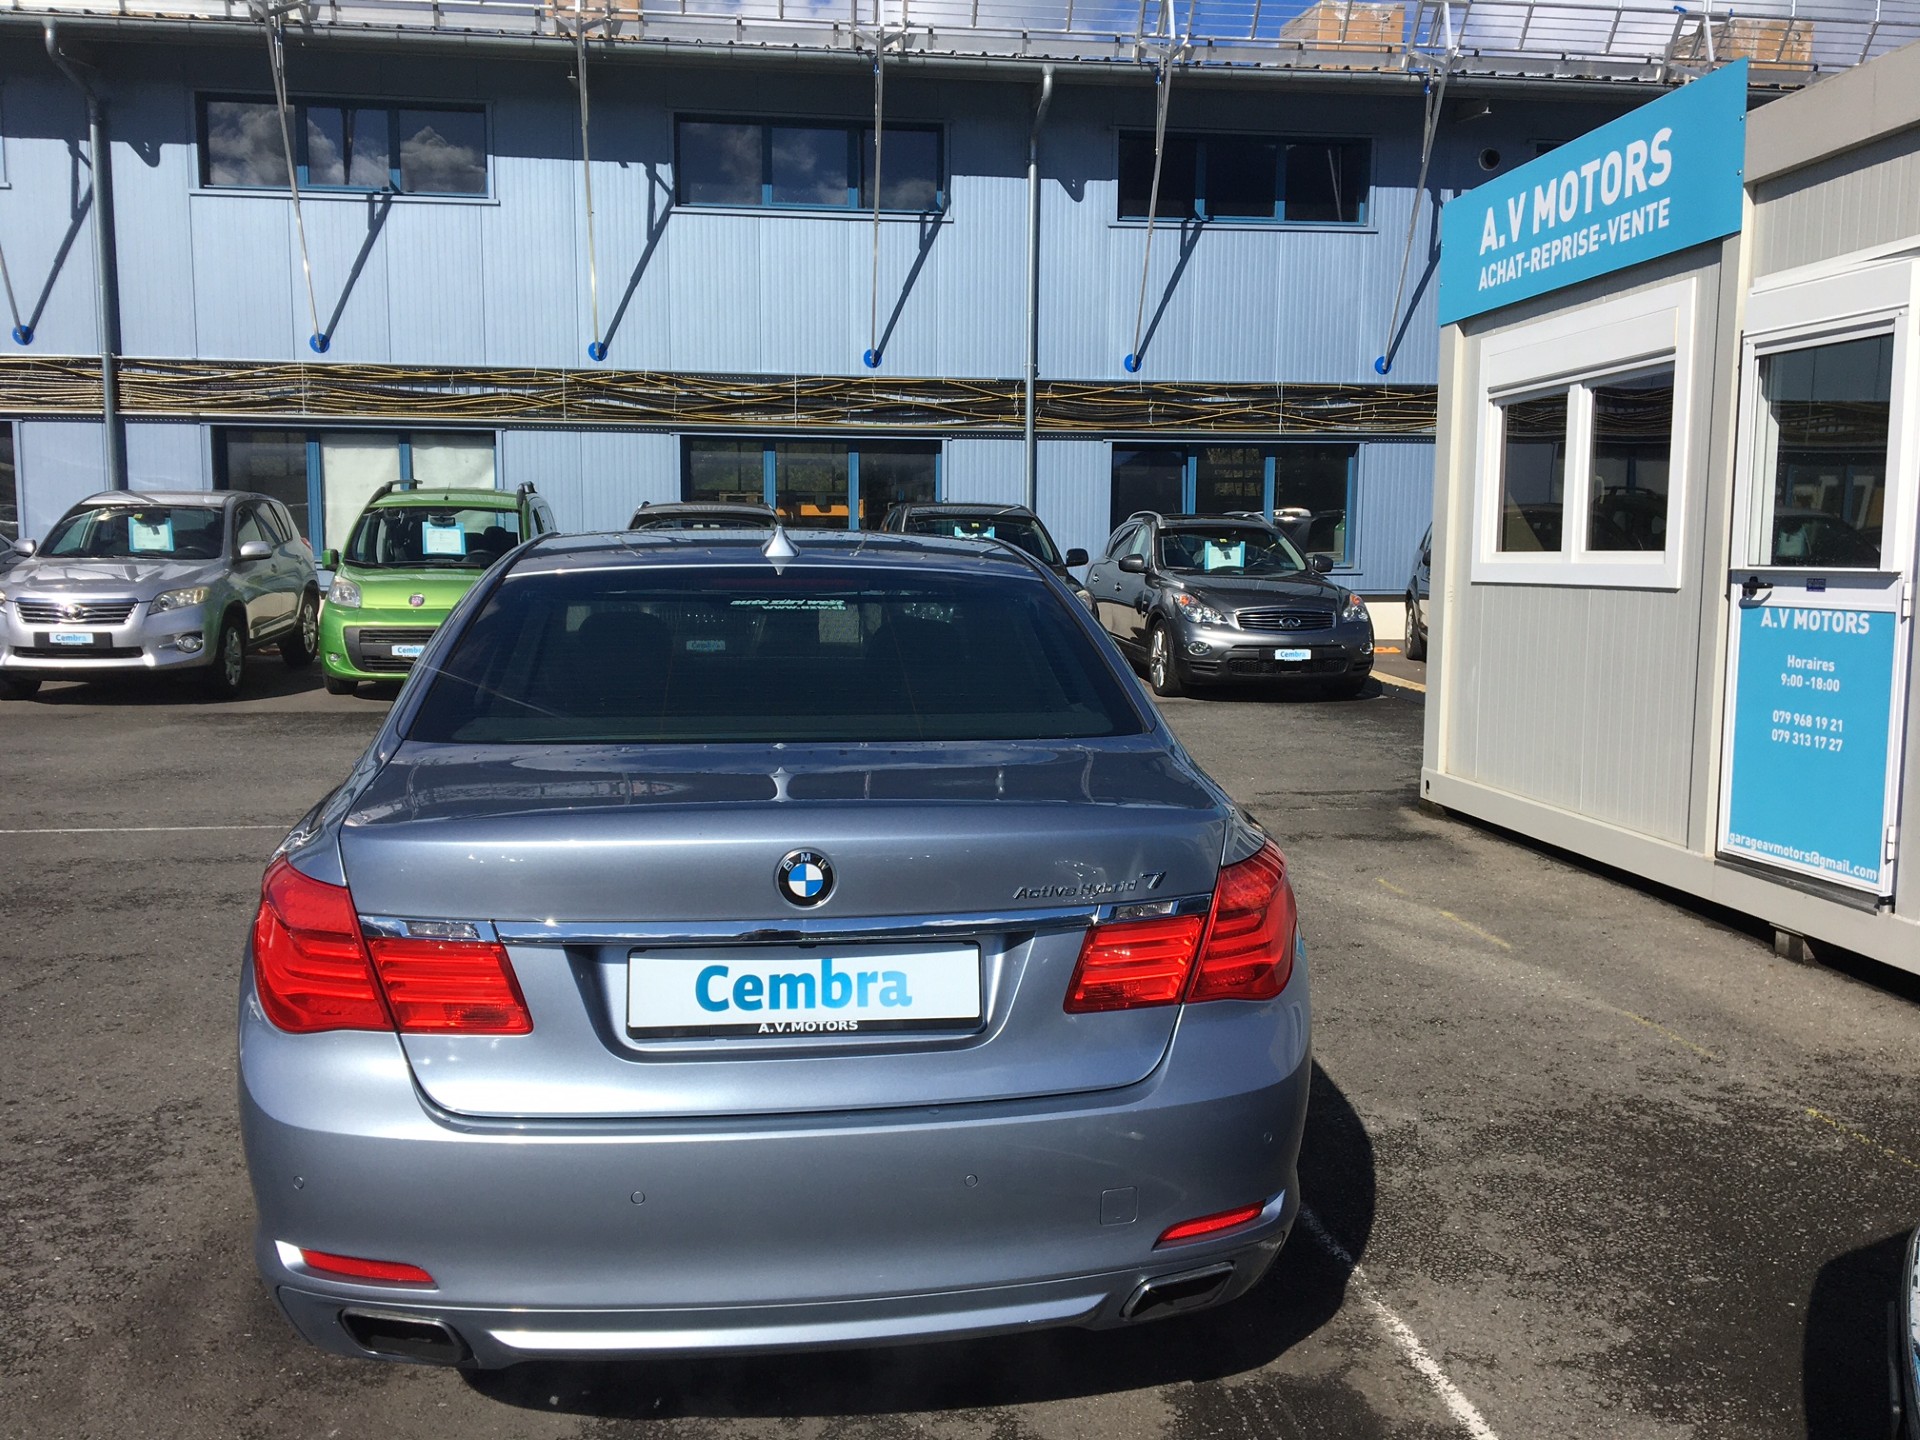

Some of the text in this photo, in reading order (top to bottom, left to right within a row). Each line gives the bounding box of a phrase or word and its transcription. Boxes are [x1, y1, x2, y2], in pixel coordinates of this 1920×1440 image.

[1478, 127, 1673, 256] A.V MOTORS
[1477, 197, 1671, 292] ACHAT-REPRISE-VENTE
[1761, 608, 1870, 634] A.V MOTORS
[1787, 654, 1836, 673] Horaires
[1780, 672, 1804, 689] 9:00
[1772, 709, 1844, 733] 079 968 19 21
[1771, 728, 1844, 753] 079 313 17 27
[783, 852, 830, 872] BMW
[1728, 832, 1878, 881] garageavmotors@gmail.com
[1138, 870, 1167, 890] 7
[694, 957, 913, 1012] Cembra
[757, 1019, 859, 1034] A.V.MOTORS
